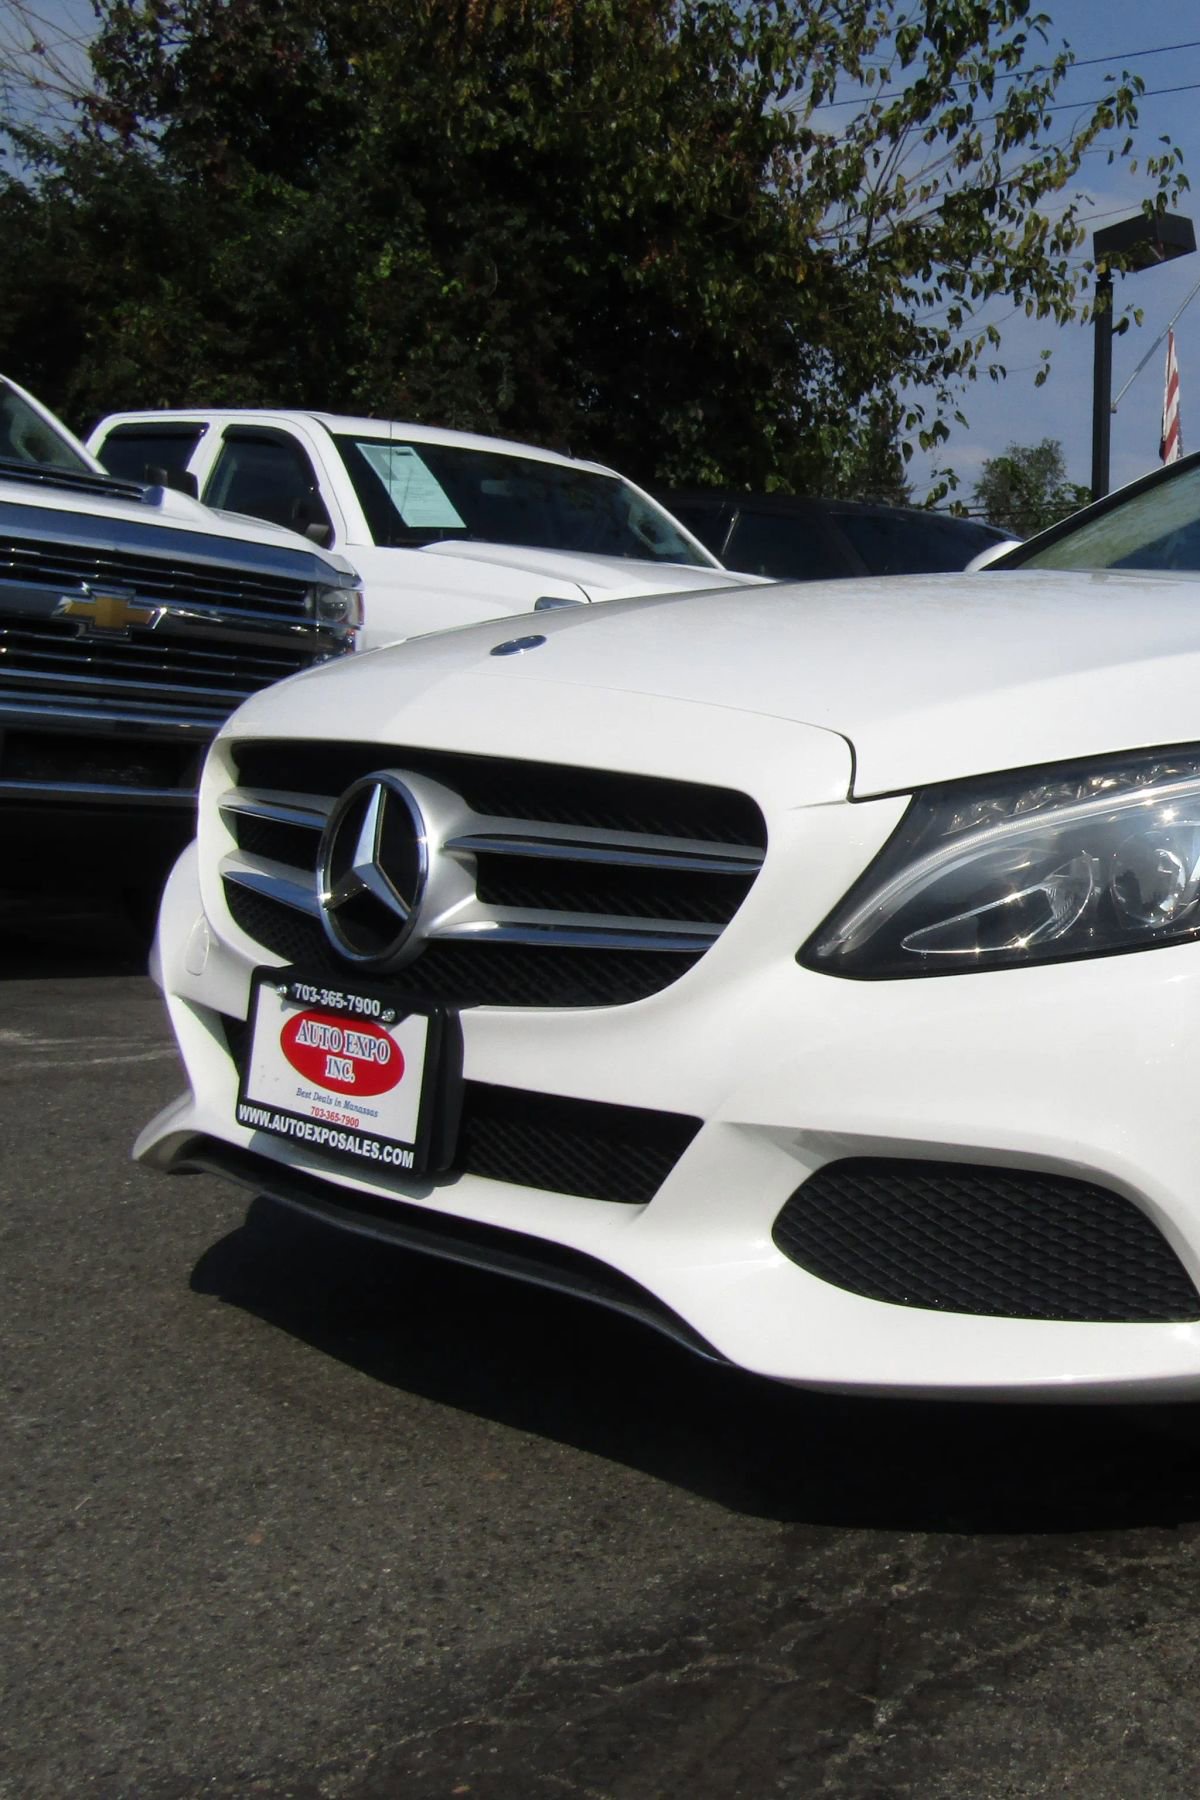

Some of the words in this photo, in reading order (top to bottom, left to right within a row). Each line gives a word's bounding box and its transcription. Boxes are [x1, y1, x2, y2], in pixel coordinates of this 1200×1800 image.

[294, 983, 381, 1017] 703-365-7900
[296, 1020, 343, 1052] AUTO
[344, 1030, 391, 1064] EXPO
[326, 1055, 355, 1083] INC.
[296, 1088, 312, 1100] Best
[313, 1092, 333, 1105] Deals
[334, 1098, 342, 1107] in
[344, 1099, 379, 1118] Manassas
[310, 1106, 360, 1128] 703-365-7900
[239, 1104, 414, 1168] WWW.AUTOEXPOSALES.COM
